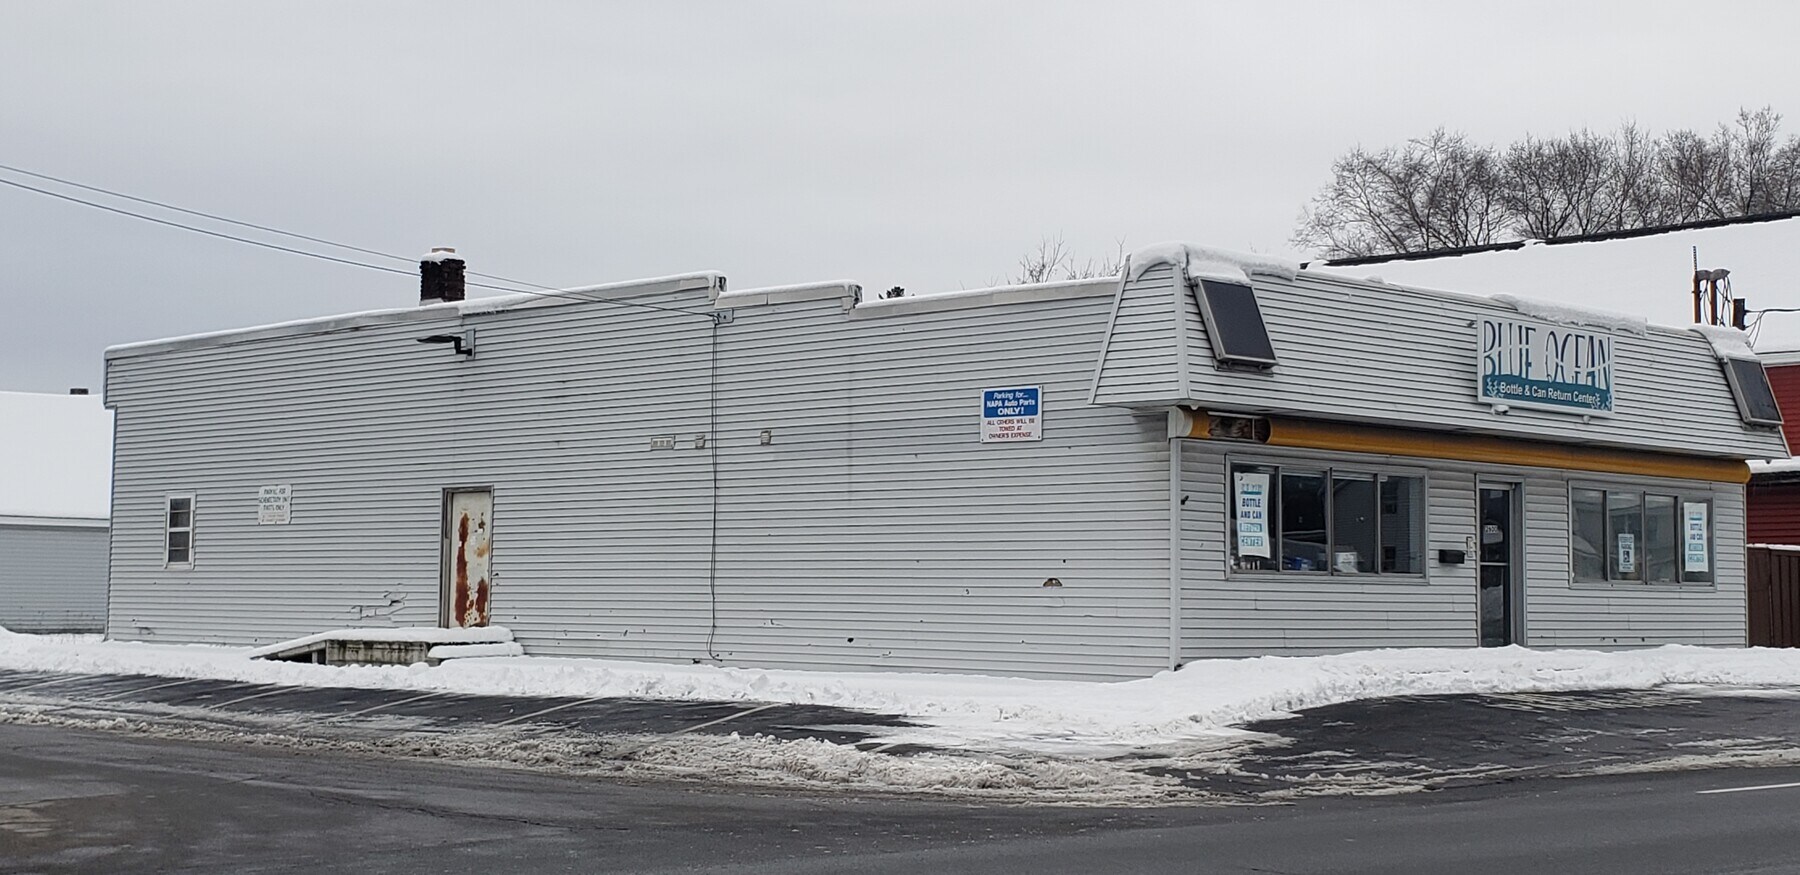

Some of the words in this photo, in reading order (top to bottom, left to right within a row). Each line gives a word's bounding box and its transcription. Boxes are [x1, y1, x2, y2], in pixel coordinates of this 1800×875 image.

[1483, 320, 1536, 380] BLUE
[1545, 330, 1611, 392] OCEAN
[993, 392, 1014, 400] Parking
[1500, 381, 1523, 396] Bottle
[1524, 385, 1530, 396] &
[1532, 386, 1547, 398] Can
[1548, 388, 1572, 401] Return
[1573, 391, 1597, 404] Center
[986, 400, 1003, 408] NAPA
[997, 407, 1025, 416] ONLY!
[1242, 498, 1261, 507] BOTTLE
[1252, 511, 1262, 519] CAN
